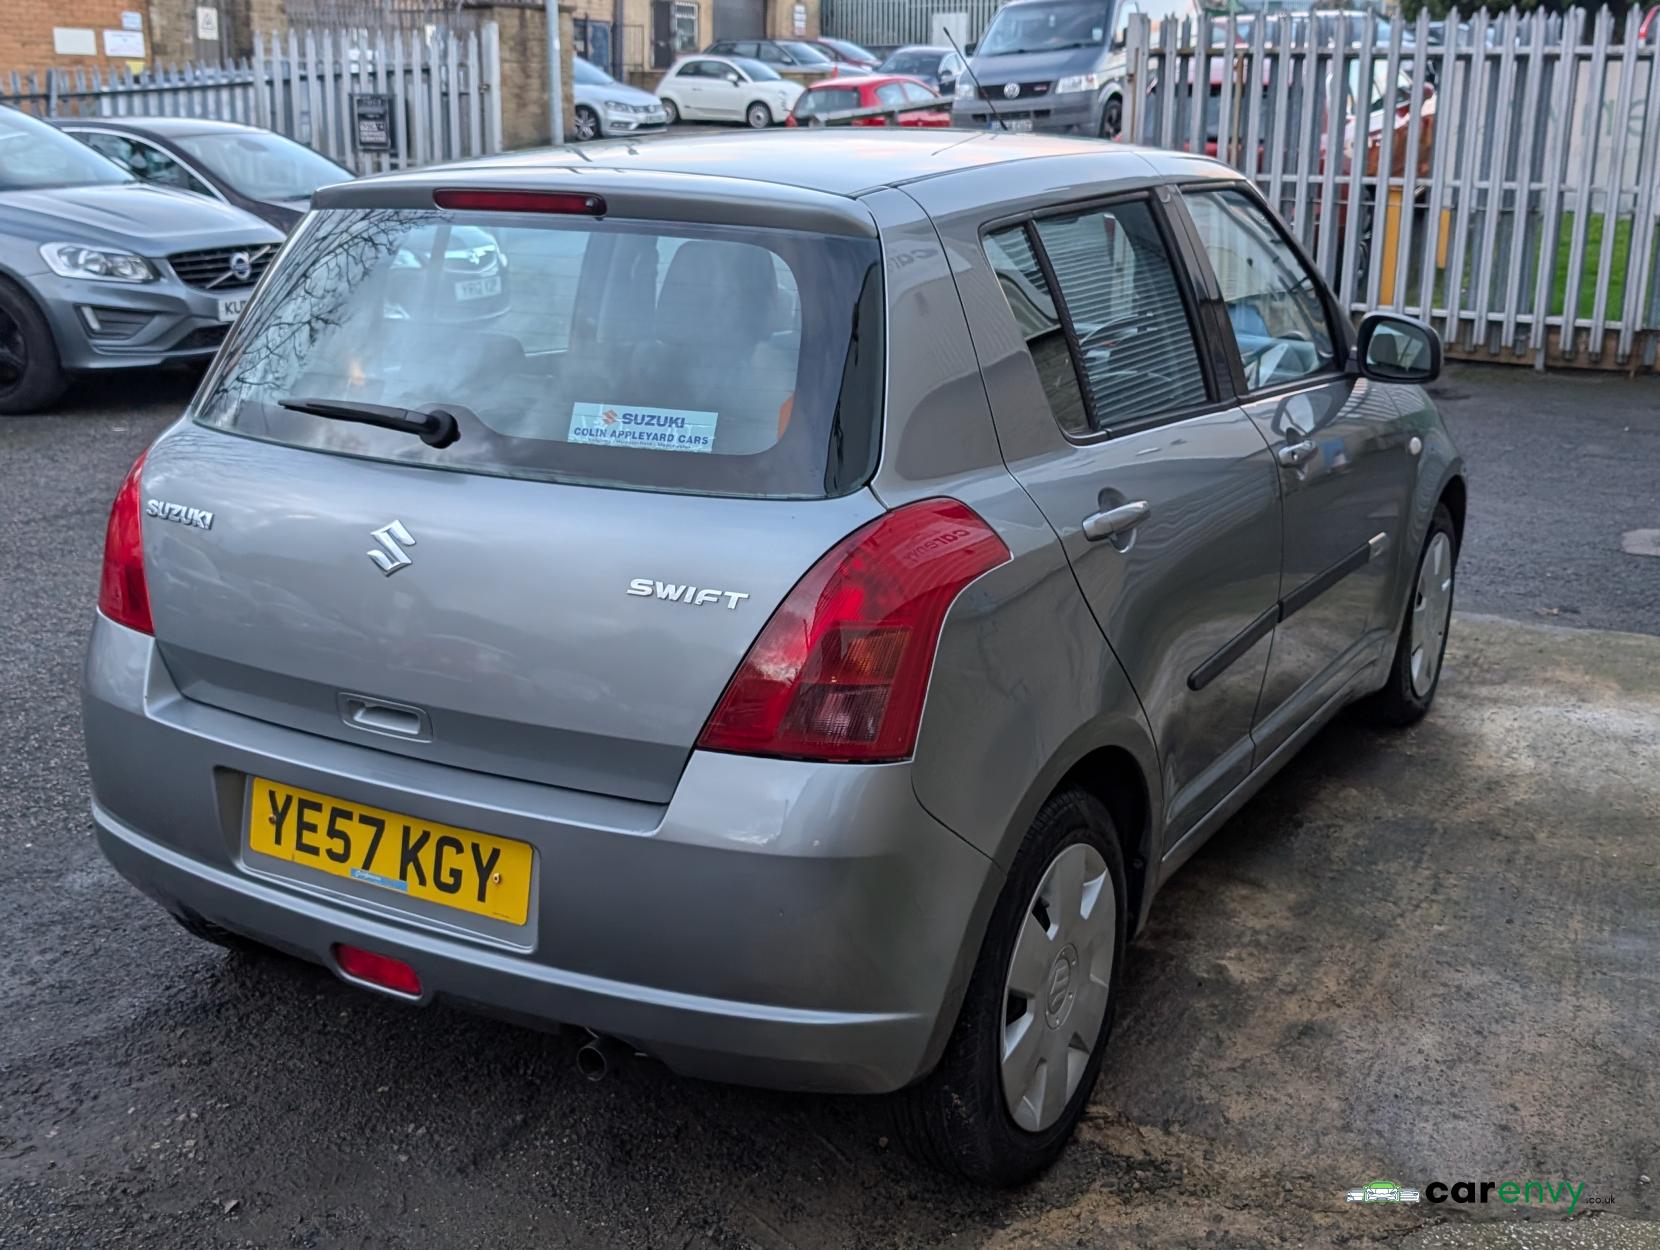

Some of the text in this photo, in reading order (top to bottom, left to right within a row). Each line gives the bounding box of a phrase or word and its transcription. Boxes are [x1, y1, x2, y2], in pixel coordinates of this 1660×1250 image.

[574, 427, 607, 438] COLIN
[610, 430, 675, 442] APPLEYARD
[678, 434, 709, 445] CARS
[622, 413, 686, 429] SUZUKI
[146, 499, 214, 530] SUZUKI
[626, 578, 750, 610] SWIFT
[268, 790, 501, 903] YE57 KGY
